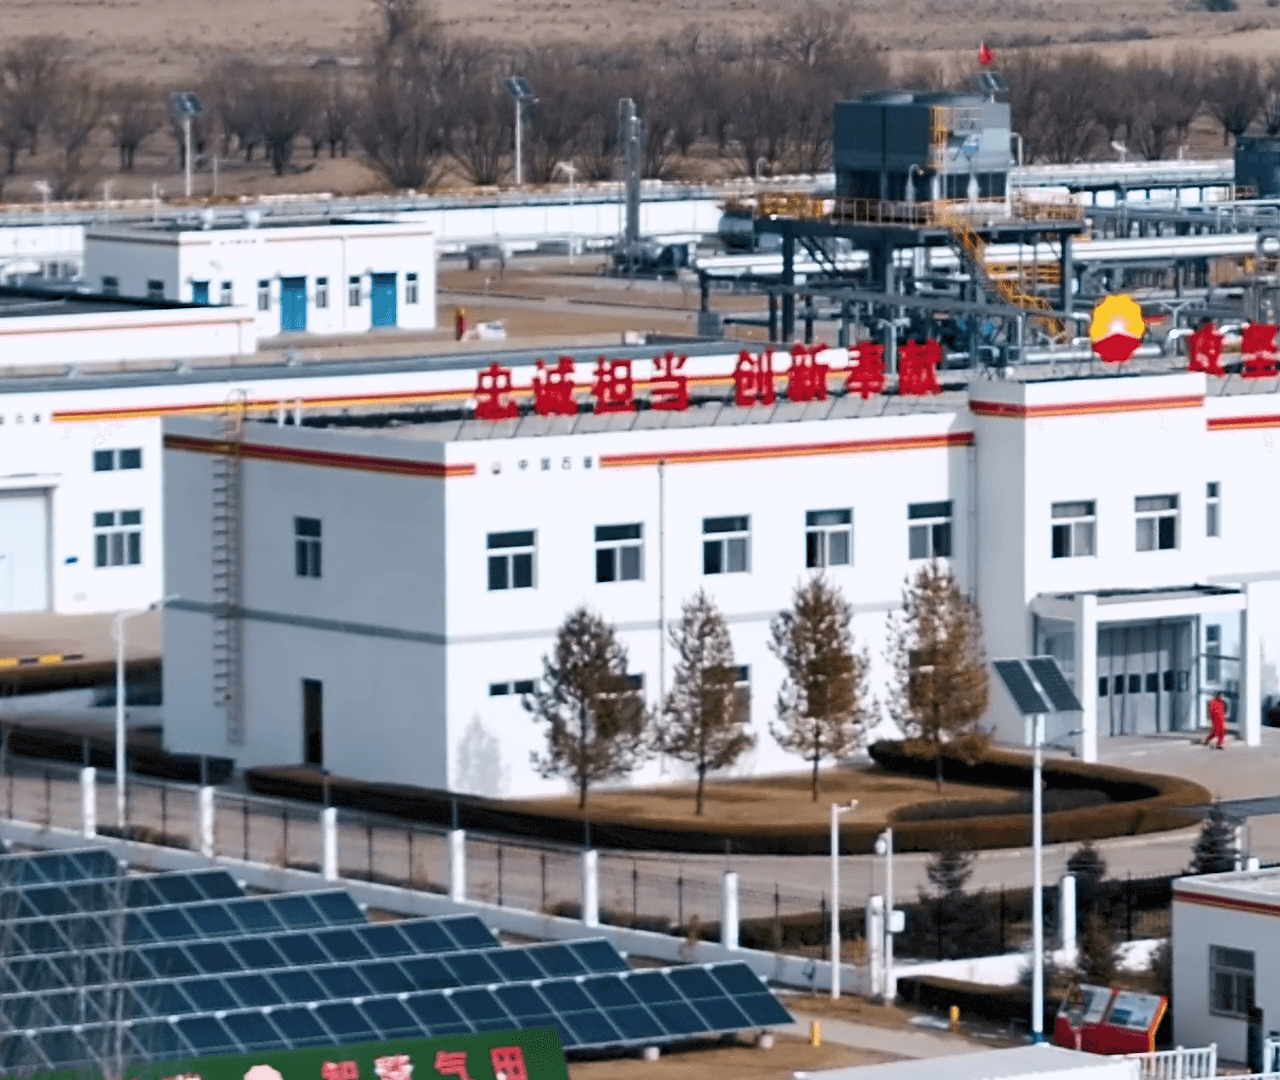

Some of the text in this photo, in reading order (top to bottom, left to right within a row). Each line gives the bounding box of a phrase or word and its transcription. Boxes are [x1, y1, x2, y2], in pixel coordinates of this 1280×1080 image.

[475, 338, 942, 420] 忠诚担当 创新奉献
